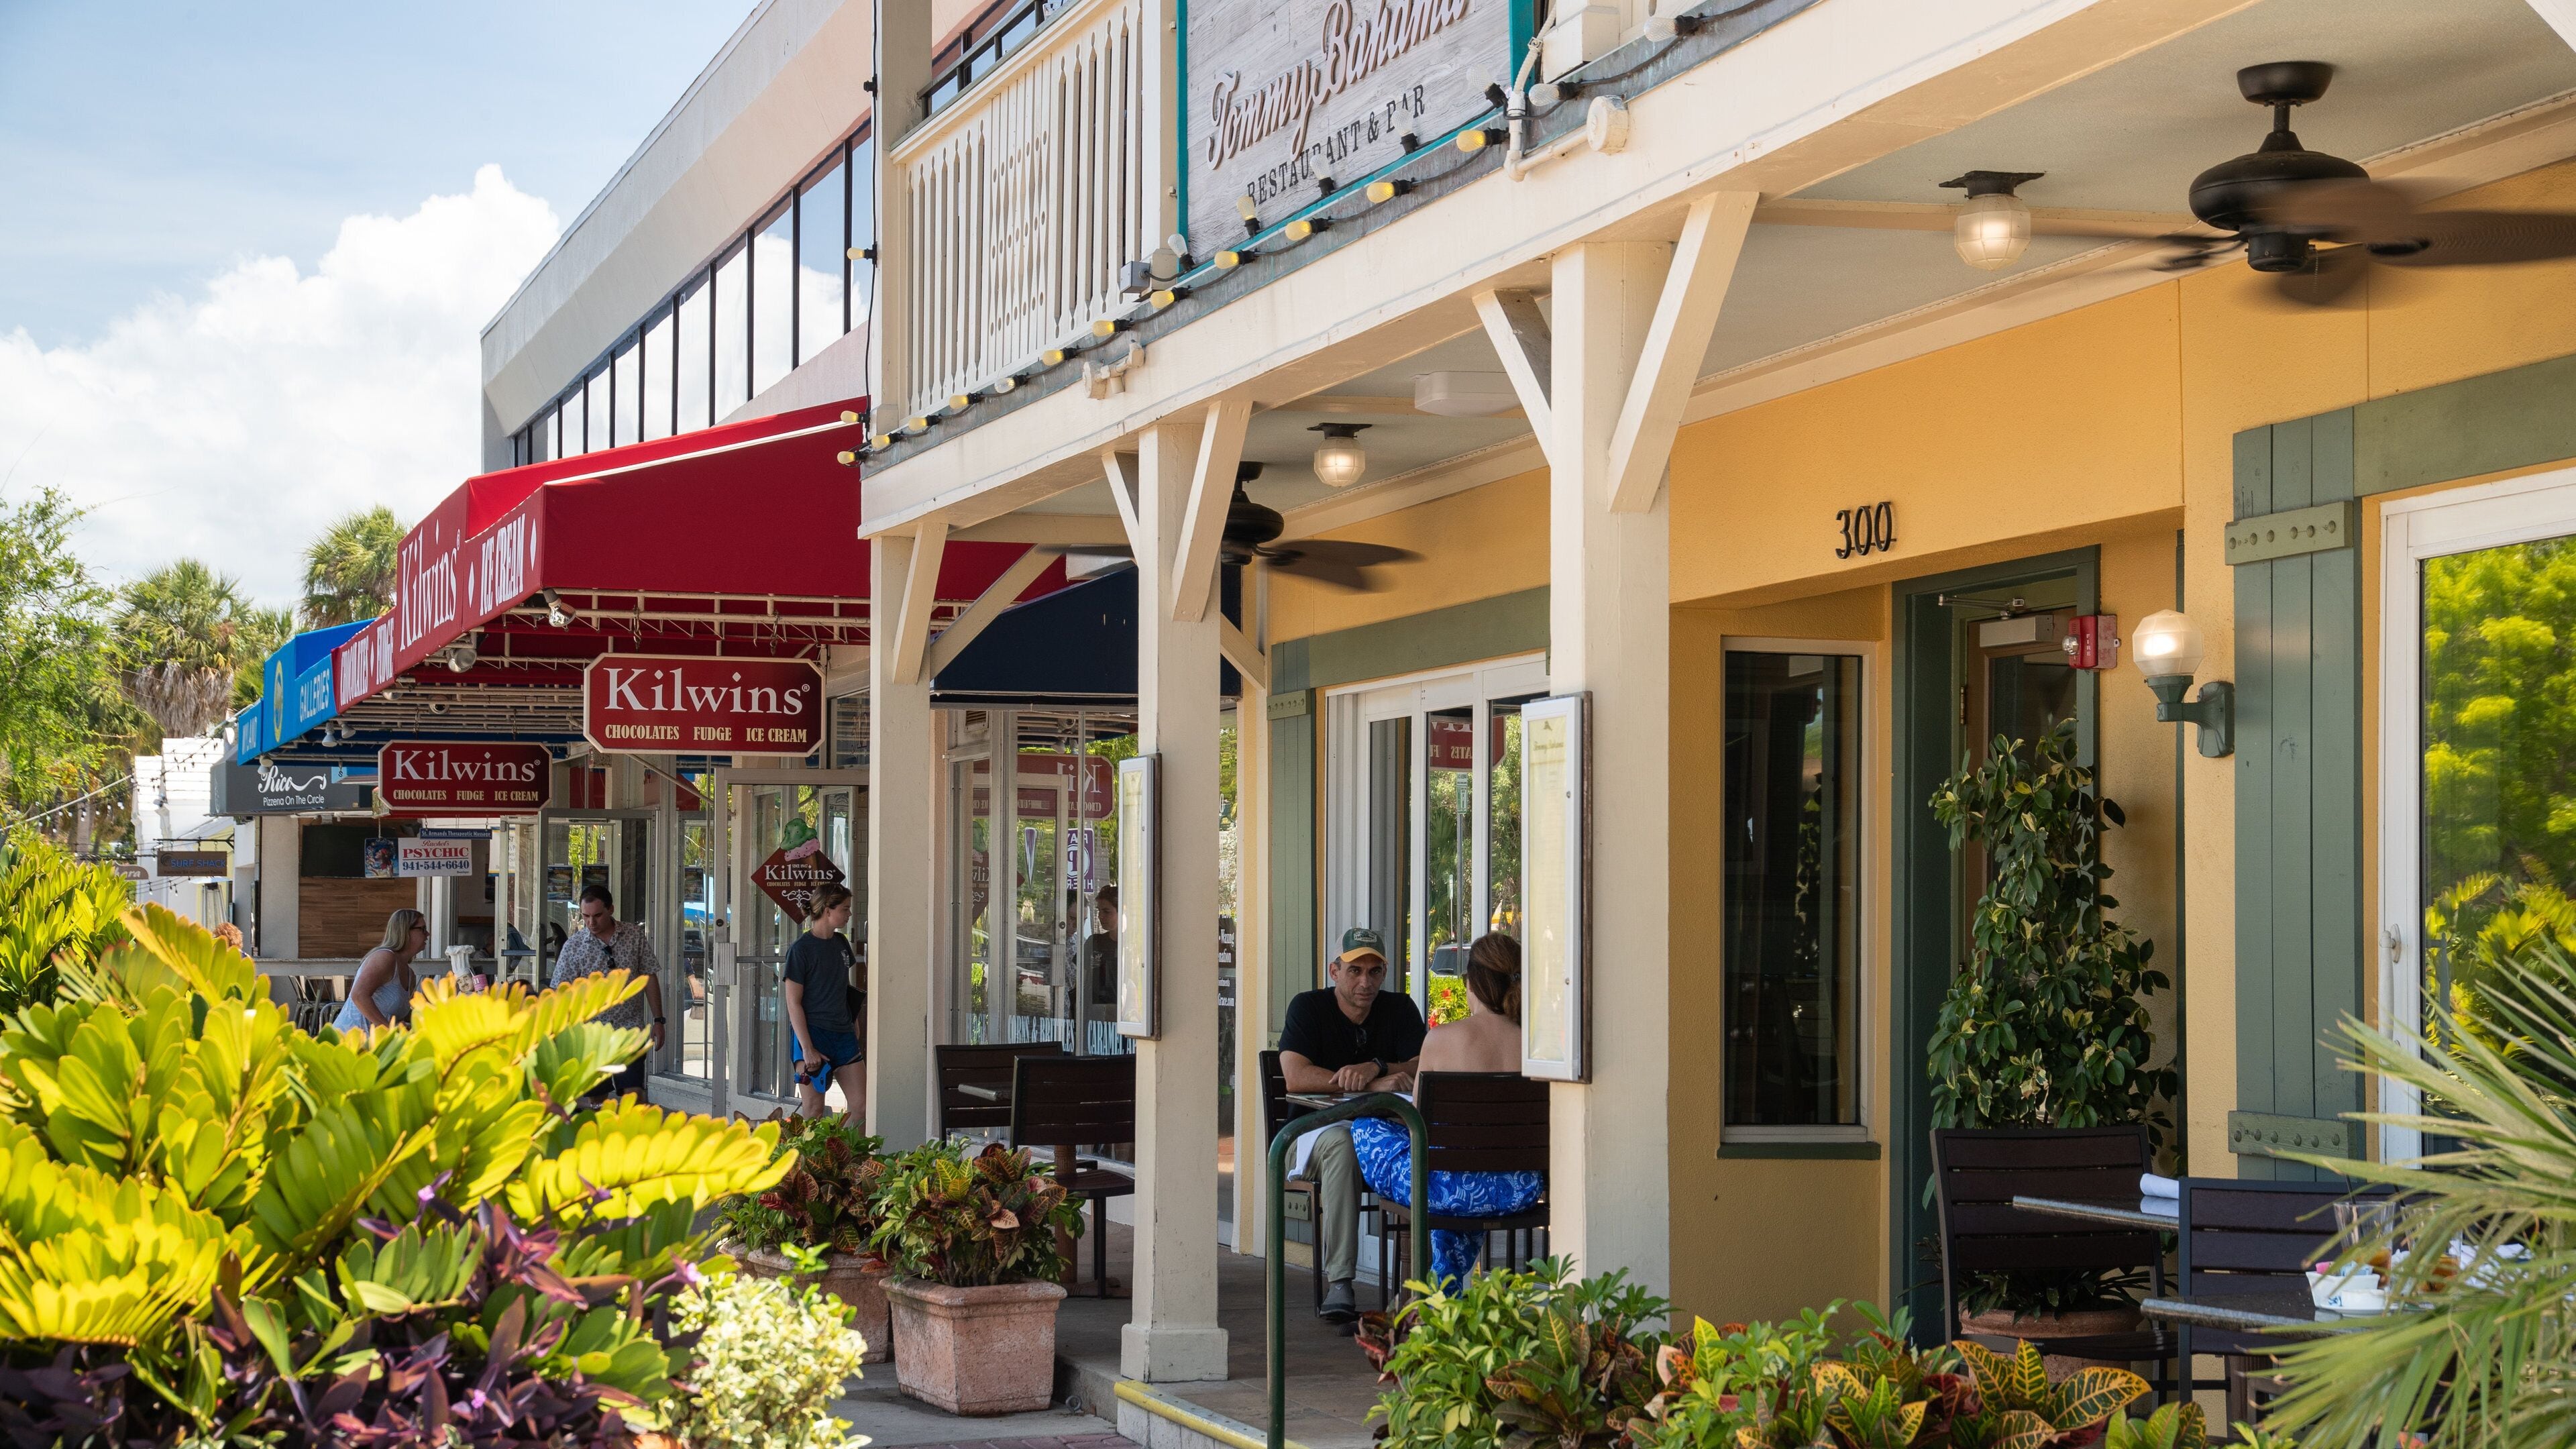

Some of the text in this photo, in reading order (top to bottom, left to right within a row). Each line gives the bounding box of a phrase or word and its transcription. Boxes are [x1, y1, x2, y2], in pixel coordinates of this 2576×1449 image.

[1208, 59, 1319, 168] Tommy
[1367, 111, 1379, 144] &
[1835, 501, 1897, 559] 300
[480, 513, 525, 616] ICE CREAM
[376, 617, 394, 686] FUDGE
[299, 668, 330, 722] GALLERIES
[605, 724, 808, 743] CHOCOLATES FUDGE ICE CREAM
[285, 795, 294, 805] On
[295, 795, 306, 804] The
[307, 794, 325, 804] Circle
[393, 790, 539, 802] CHOCOLATES FUDGE ICE CREAM
[171, 859, 226, 868] SURF SHACK
[402, 847, 469, 859] PSYCHIC
[402, 860, 470, 871] 941-544-6640
[1031, 1016, 1038, 1042] &
